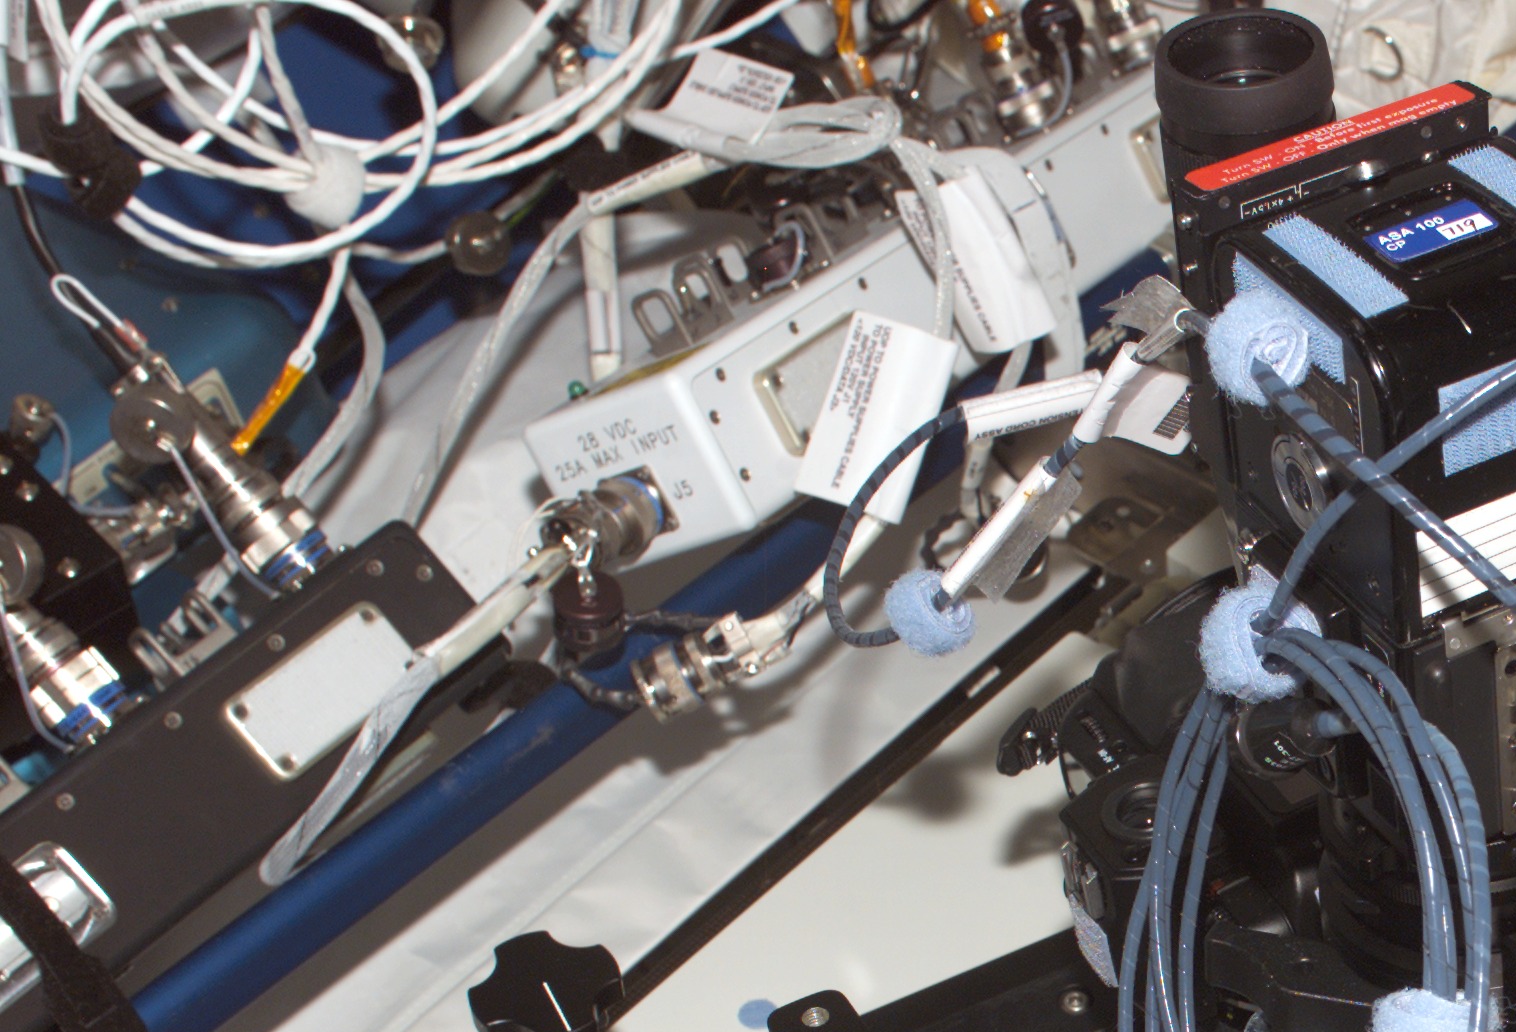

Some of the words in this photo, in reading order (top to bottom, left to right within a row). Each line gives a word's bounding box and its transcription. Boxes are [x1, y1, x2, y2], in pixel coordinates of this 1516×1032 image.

[1220, 171, 1249, 183] Turn
[1250, 162, 1271, 173] SW
[1282, 150, 1306, 162] OFF
[1316, 137, 1347, 150] Only
[1349, 124, 1385, 139] when
[1387, 112, 1417, 126] mag
[1417, 98, 1456, 116] empty
[1221, 161, 1251, 175] Turn
[1252, 153, 1273, 165] SW
[1283, 142, 1306, 153] ON
[1314, 126, 1354, 143] Before
[1355, 116, 1381, 129] first
[1384, 97, 1437, 119] exposure
[1293, 119, 1355, 144] CAUTION
[1377, 226, 1415, 245] ASA
[1414, 215, 1445, 230] 100
[1441, 217, 1478, 235] 719
[1385, 238, 1405, 251] CP
[871, 324, 883, 337] TO
[854, 334, 870, 364] INPUT
[859, 339, 877, 378] POWER
[873, 350, 885, 365] TO
[847, 380, 865, 418] SUPPLY
[860, 366, 879, 404] POWER
[575, 429, 600, 452] 28
[602, 416, 638, 442] VDC
[843, 405, 866, 455] SUPPLIES
[1005, 419, 1036, 433] CORD
[553, 457, 588, 482] 25A
[590, 443, 624, 470] MAX
[628, 423, 679, 456] INPUT
[672, 476, 695, 501] J5
[829, 456, 849, 490] CABLE
